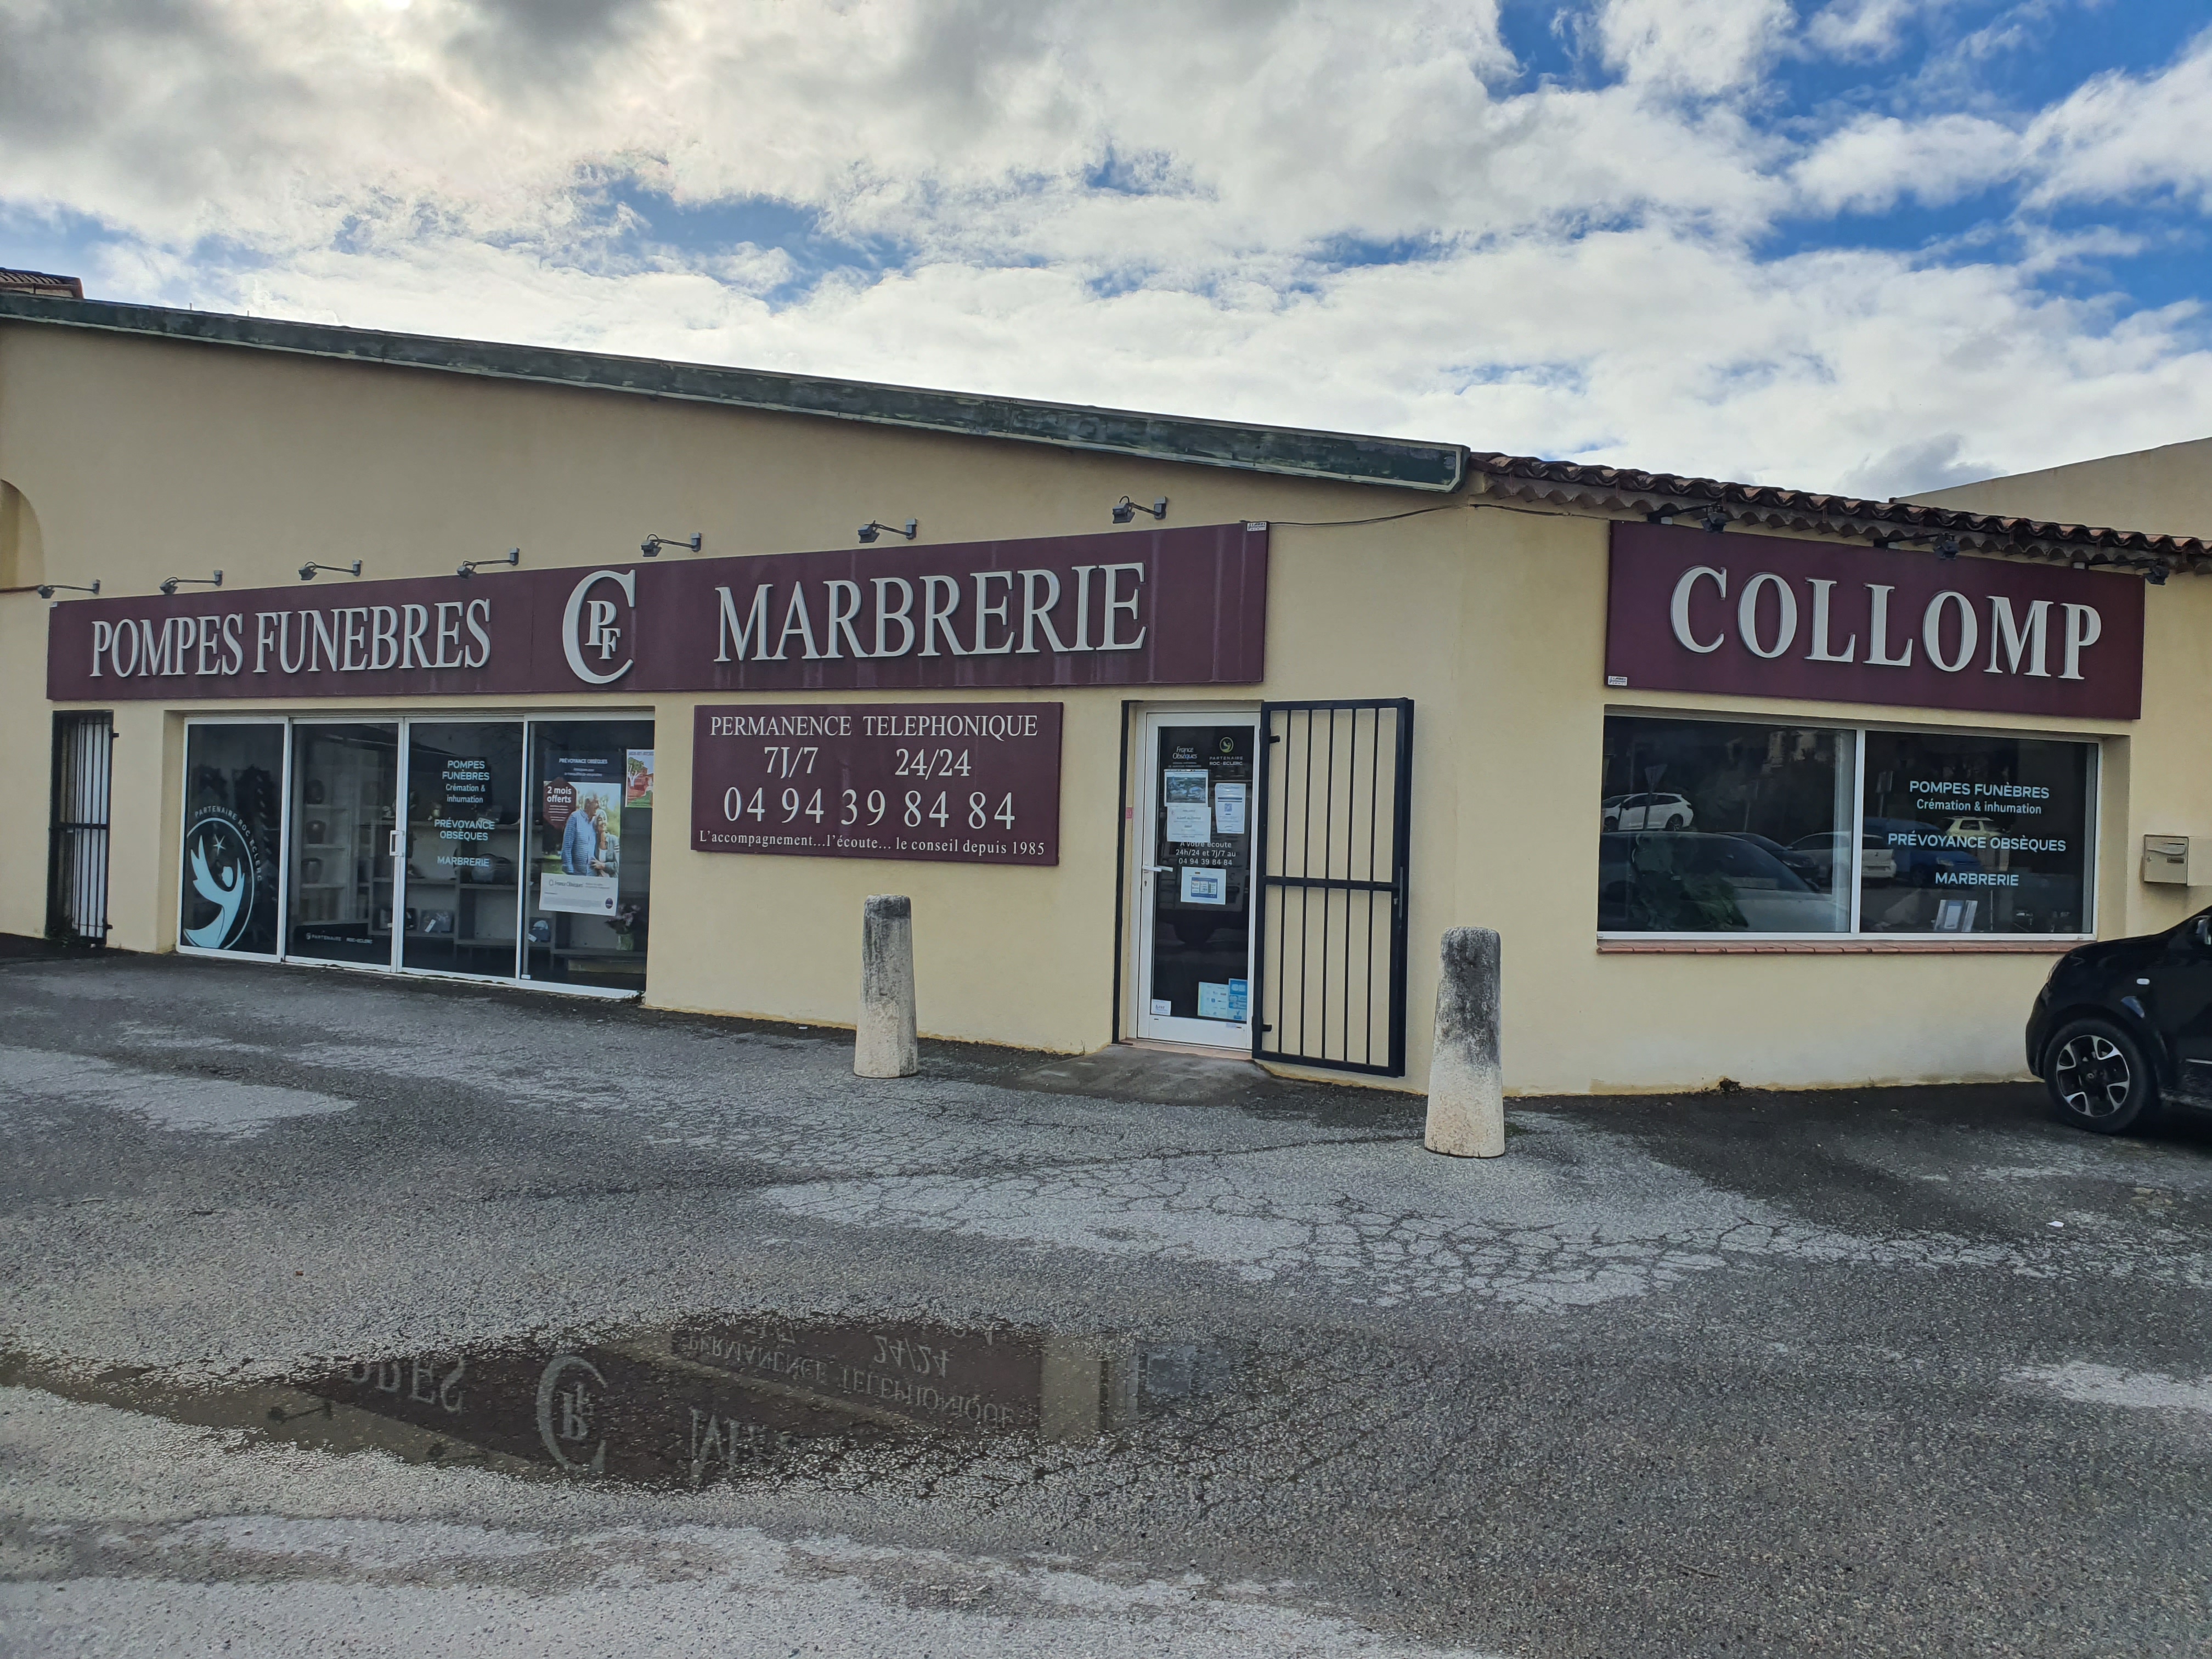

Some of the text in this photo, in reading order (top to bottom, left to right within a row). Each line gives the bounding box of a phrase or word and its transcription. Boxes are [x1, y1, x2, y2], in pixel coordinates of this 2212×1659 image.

[713, 562, 1147, 662] MARBRERIE
[1671, 565, 2102, 680] COLLOMP
[89, 598, 492, 678] POMPES FUNEBRES
[709, 715, 1039, 741] PERMANENCE TELEPHONIQUE
[447, 760, 485, 769] POMPES
[764, 747, 972, 780] 7J/7 24/24
[442, 769, 490, 780] FUNÈBRES
[445, 783, 479, 792] Crémation
[554, 786, 572, 794] mois
[1909, 780, 2050, 798] POMPES FUNÈBRES
[447, 794, 483, 803] inhumation
[546, 794, 572, 803] offerts
[195, 805, 238, 820] PARTENAIRE
[724, 787, 1015, 830] 04 94 39 84 84
[1916, 799, 2041, 814] Crémation & inhumation
[434, 817, 495, 830] PRÉVOYANCE
[439, 828, 488, 842] OBSÈQUES
[1888, 831, 2067, 852] PRÉVOYANCE OBSÈQUES
[896, 837, 907, 850] le
[911, 838, 958, 852] conseil
[963, 839, 1007, 856] depuis
[1013, 841, 1045, 855] 1985
[1211, 850, 1225, 858] 7j/7
[437, 856, 490, 867] MARBRERIE
[1935, 872, 2019, 887] MARBRERIE
